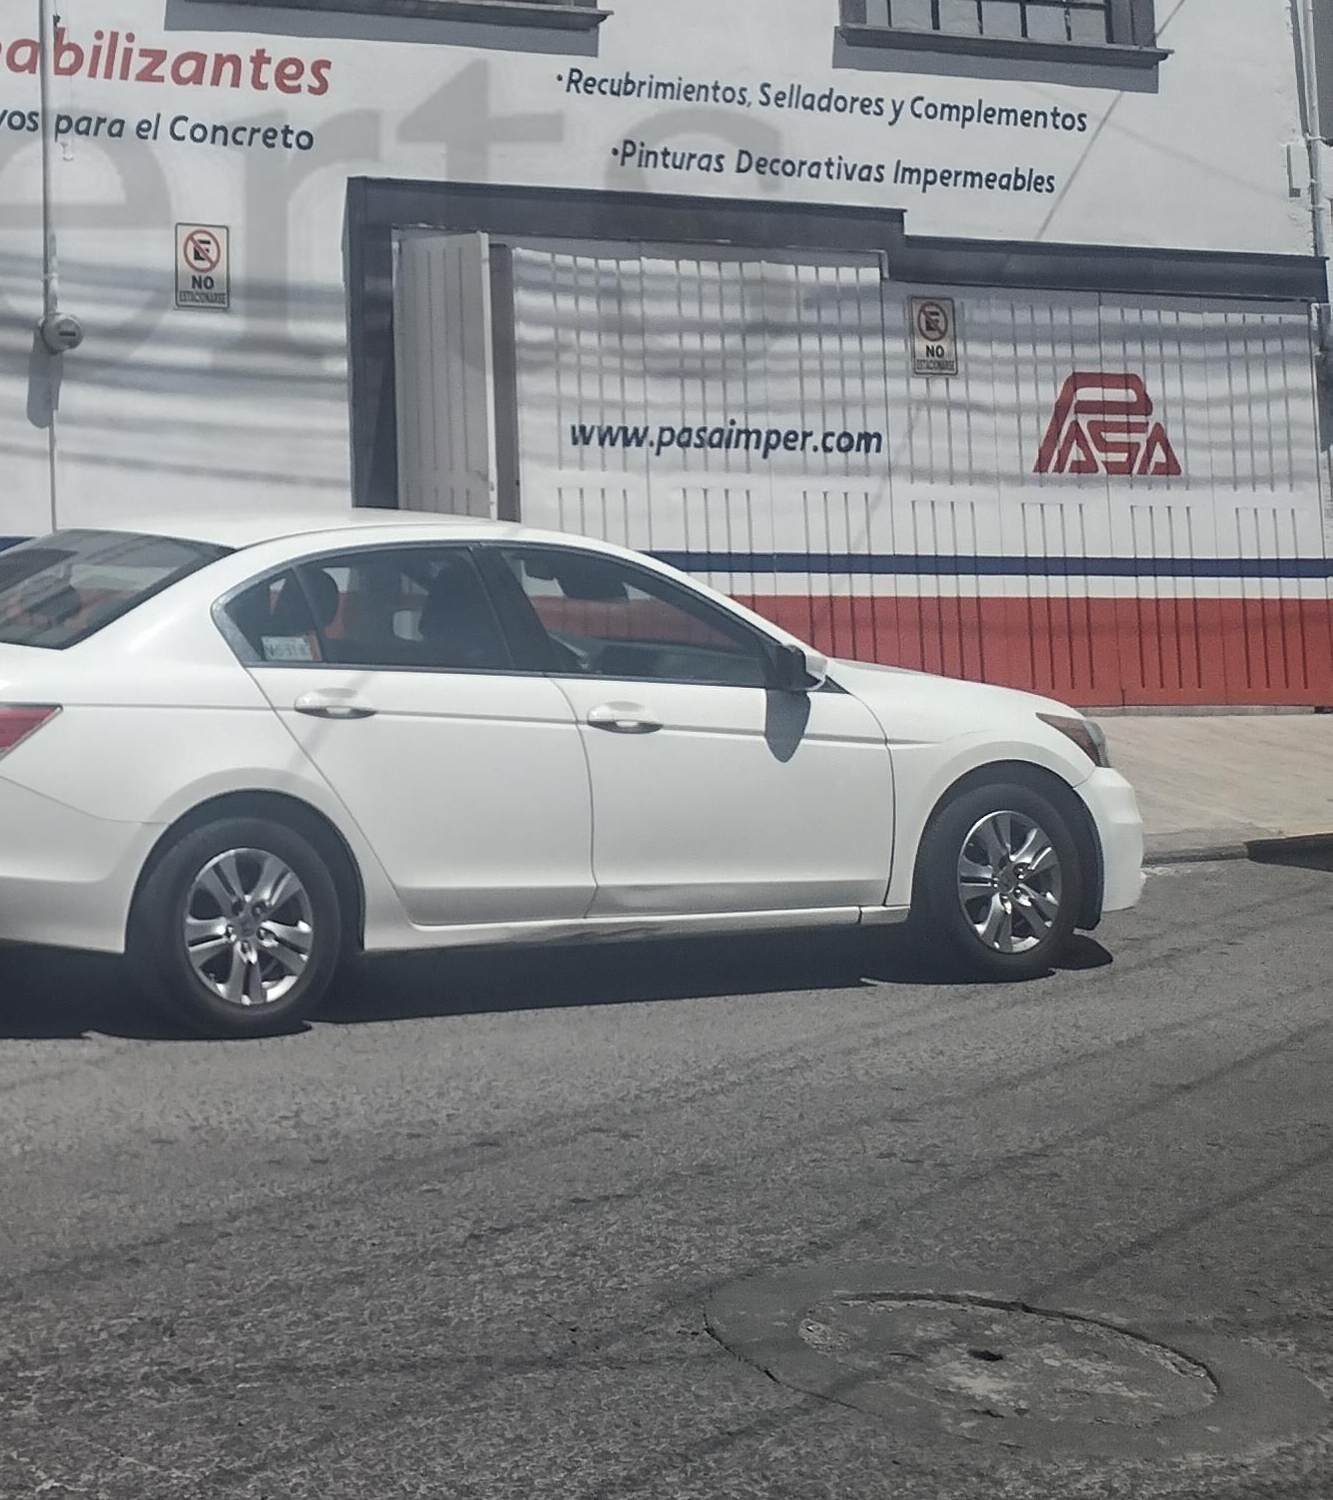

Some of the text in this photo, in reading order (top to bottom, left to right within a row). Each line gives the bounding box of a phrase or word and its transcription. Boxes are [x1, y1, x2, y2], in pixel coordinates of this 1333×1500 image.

[565, 68, 1088, 133] Recubrimientos, Selladores y Complementos
[54, 112, 126, 143] para
[136, 112, 161, 141] el
[169, 114, 315, 151] Concreto
[619, 139, 1056, 194] Pinturas Decorativas Impermeables
[191, 275, 215, 290] NO
[925, 344, 945, 358] NO
[570, 418, 883, 460] www.pasaimper.com
